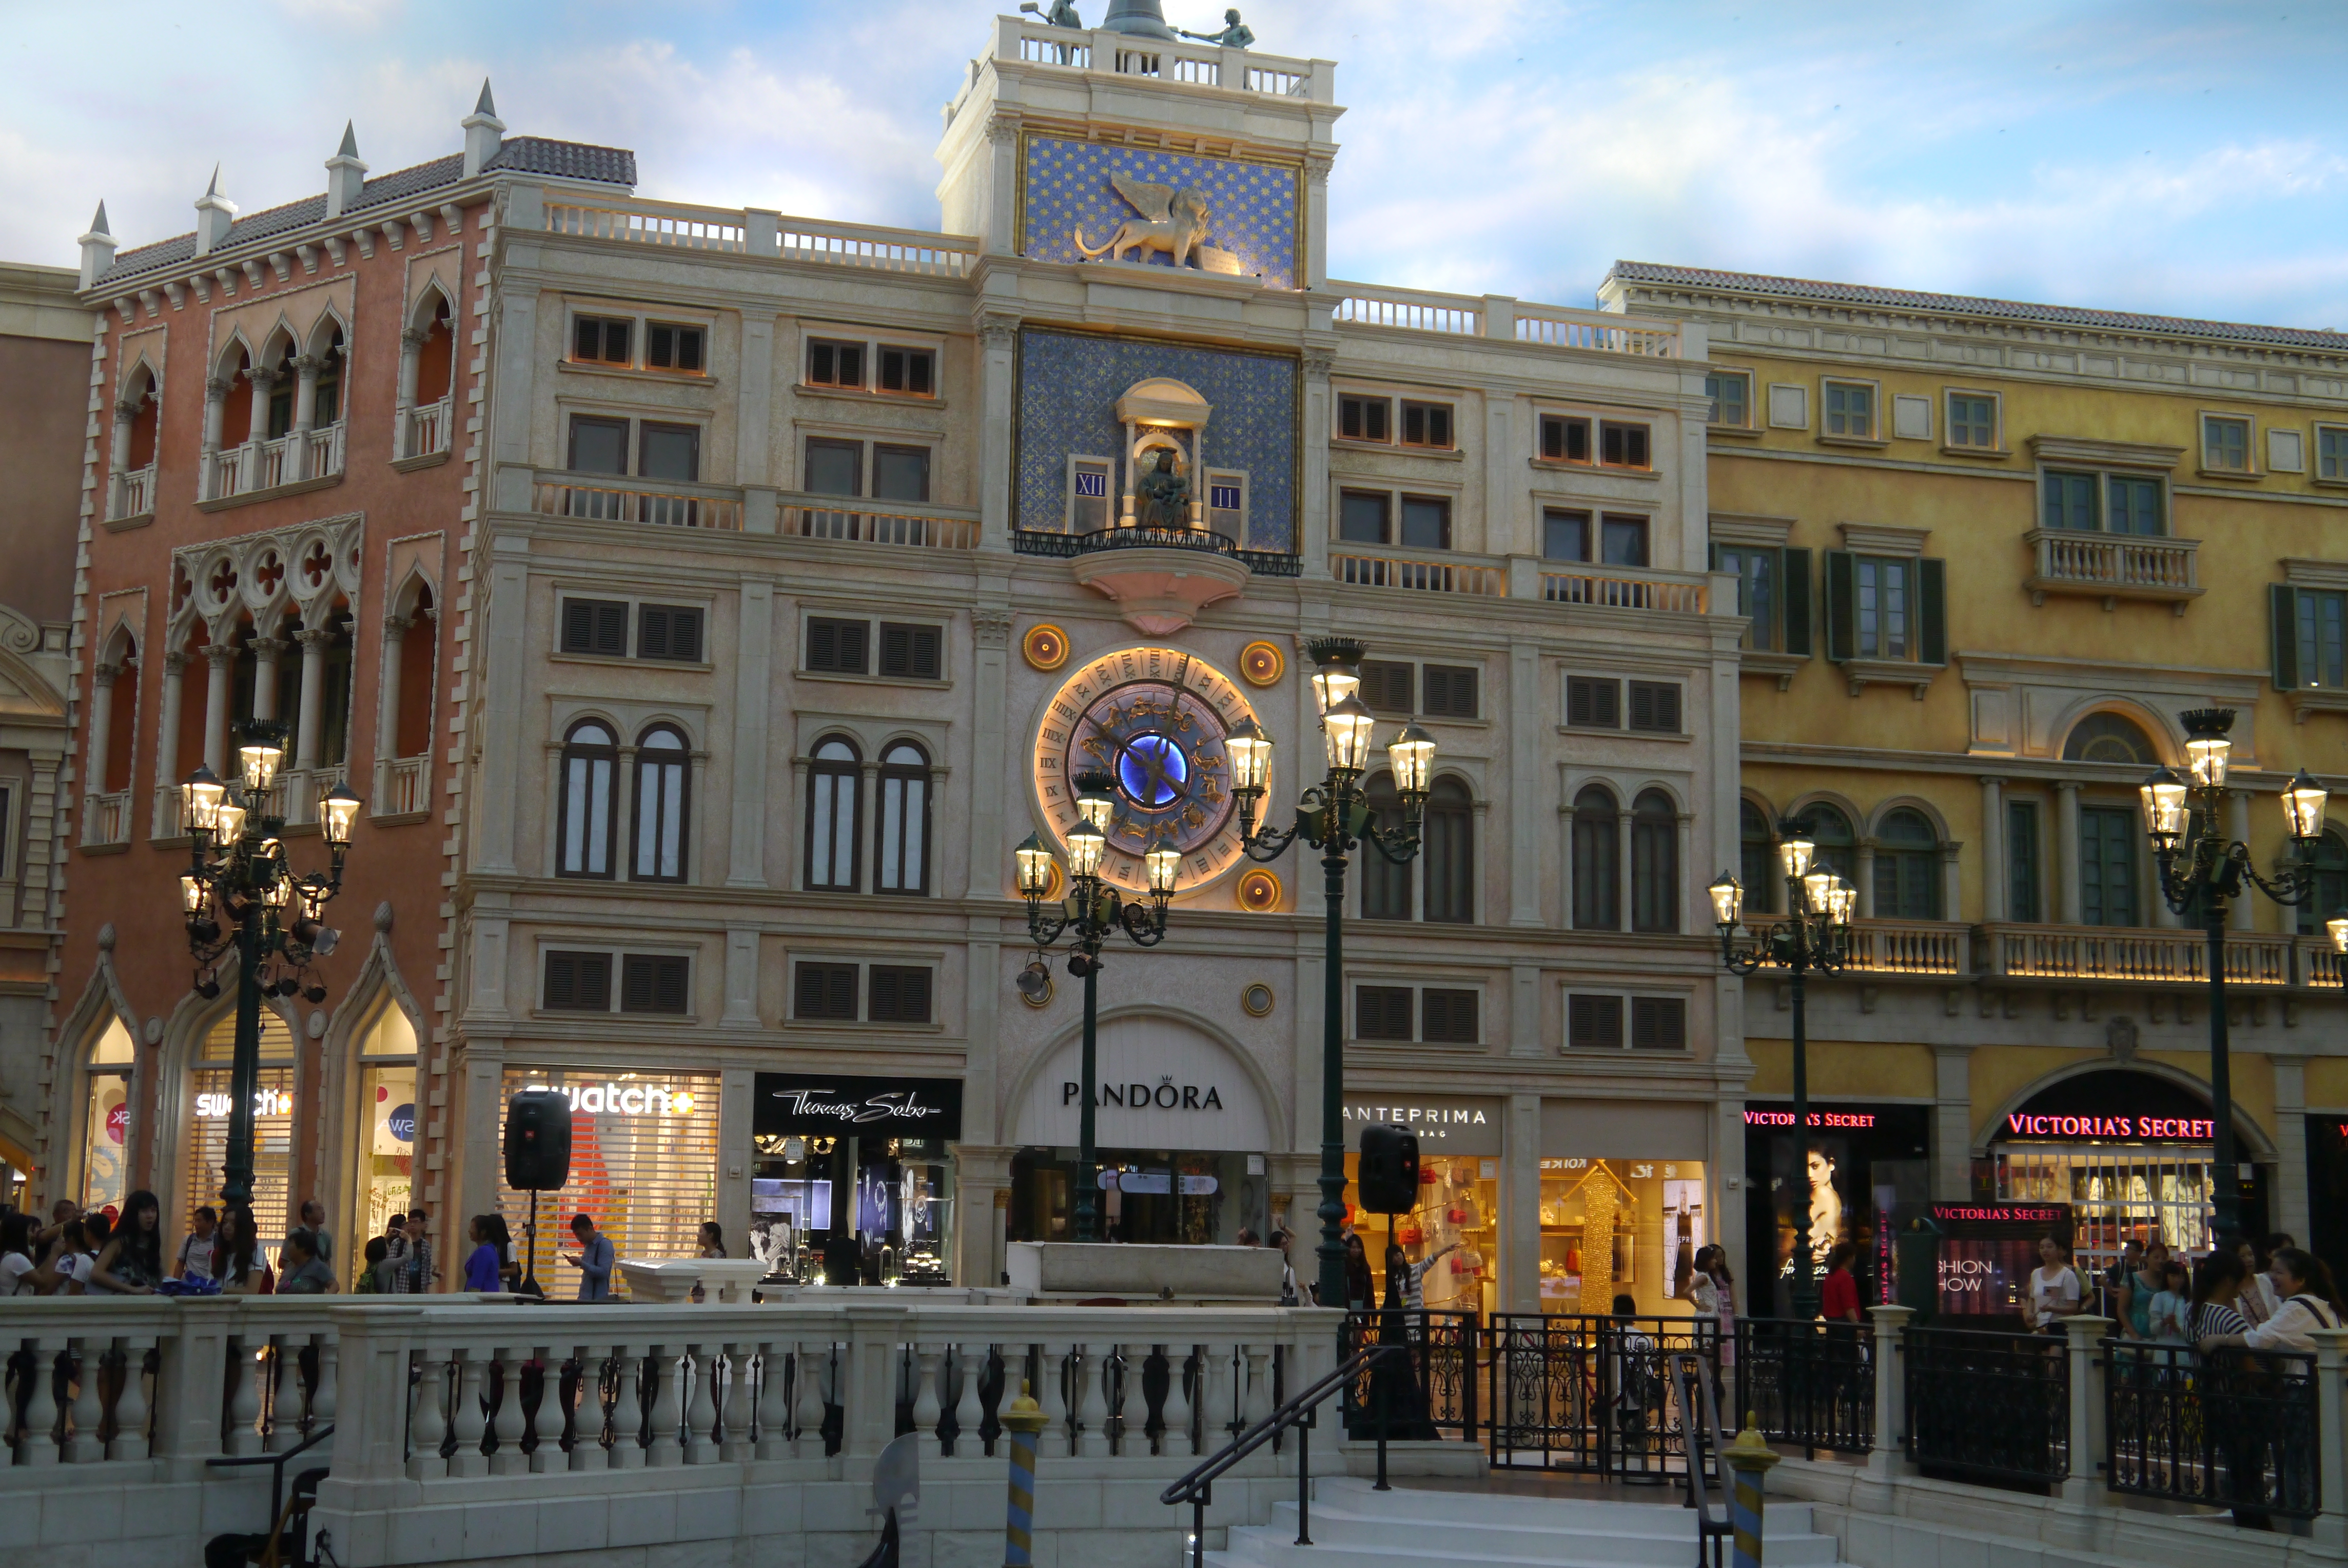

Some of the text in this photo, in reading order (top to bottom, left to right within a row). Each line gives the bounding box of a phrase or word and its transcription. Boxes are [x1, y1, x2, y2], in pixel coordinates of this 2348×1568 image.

[1078, 474, 1103, 496] XII
[197, 1089, 278, 1116] swch
[526, 1083, 671, 1114] atch
[773, 1089, 943, 1123] Thomas Sabo
[1063, 1081, 1223, 1110] PNDORA
[1343, 1107, 1486, 1124] ANTEPRIMA
[1744, 1111, 1875, 1127] VICTOR'S SECRET
[2008, 1113, 2215, 1138] VICTORIA'S SECRET
[1934, 1207, 2062, 1221] VICTORIA'S SECRET
